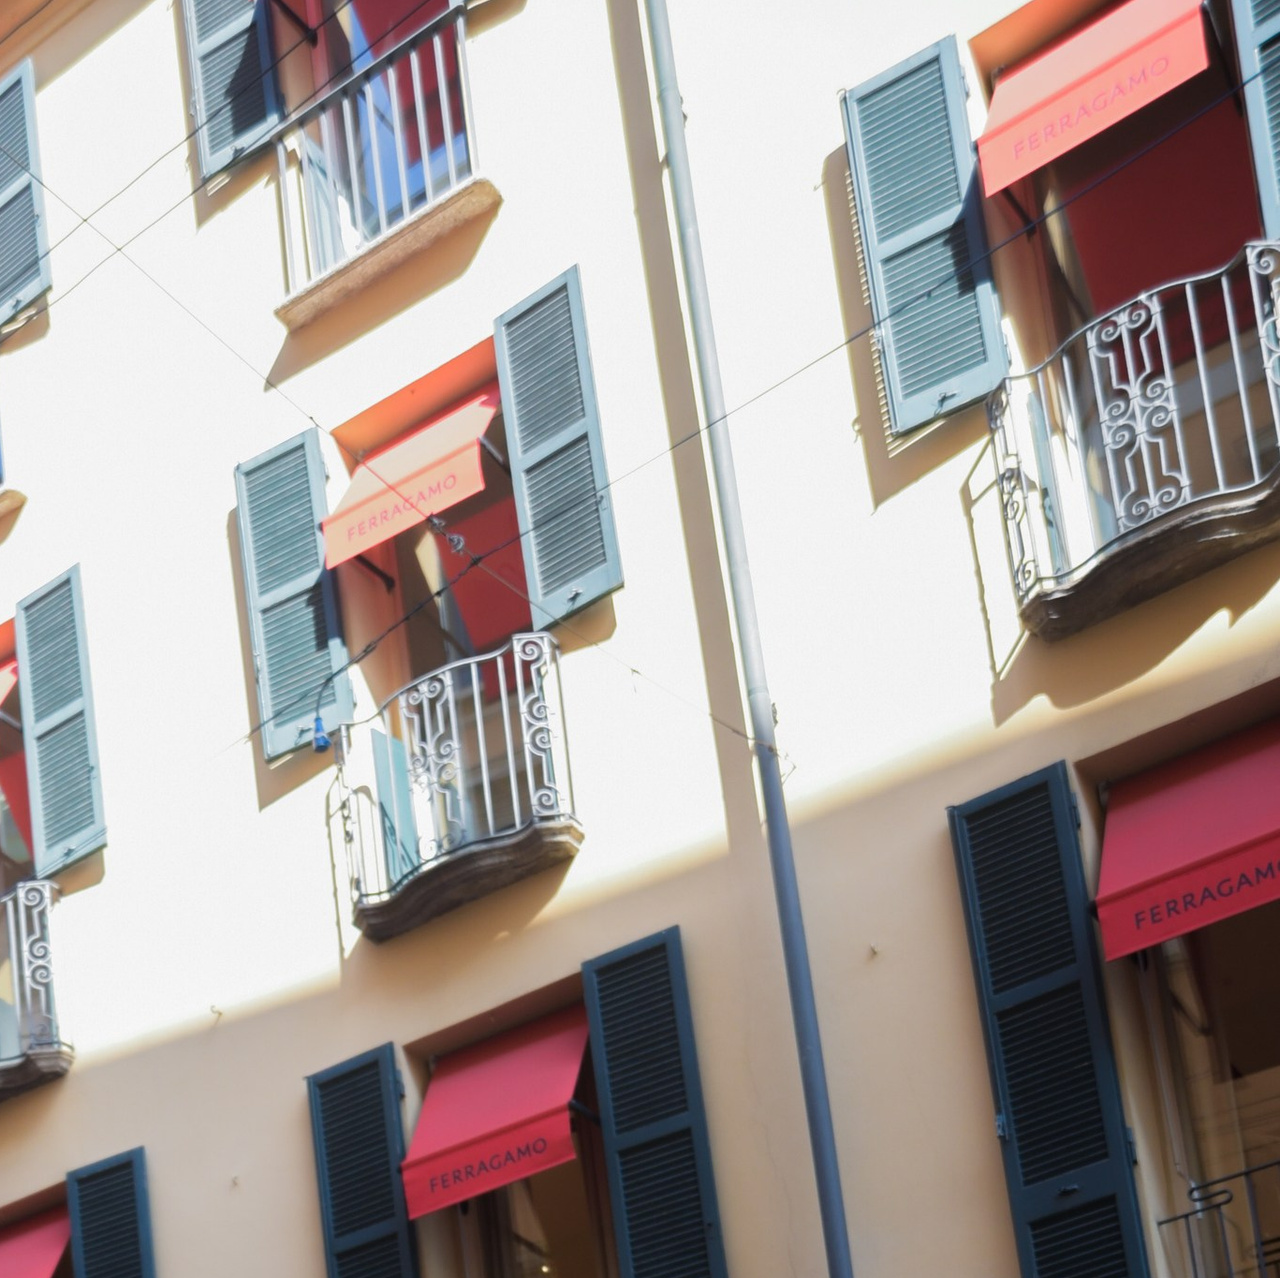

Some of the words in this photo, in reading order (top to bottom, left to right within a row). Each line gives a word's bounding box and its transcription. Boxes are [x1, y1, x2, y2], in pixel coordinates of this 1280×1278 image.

[1013, 57, 1169, 160] FERRAGAMO
[347, 474, 457, 543] FERRAGAMO
[1134, 860, 1280, 930] FERRAGAM
[429, 1137, 548, 1193] FERRAGAMO
